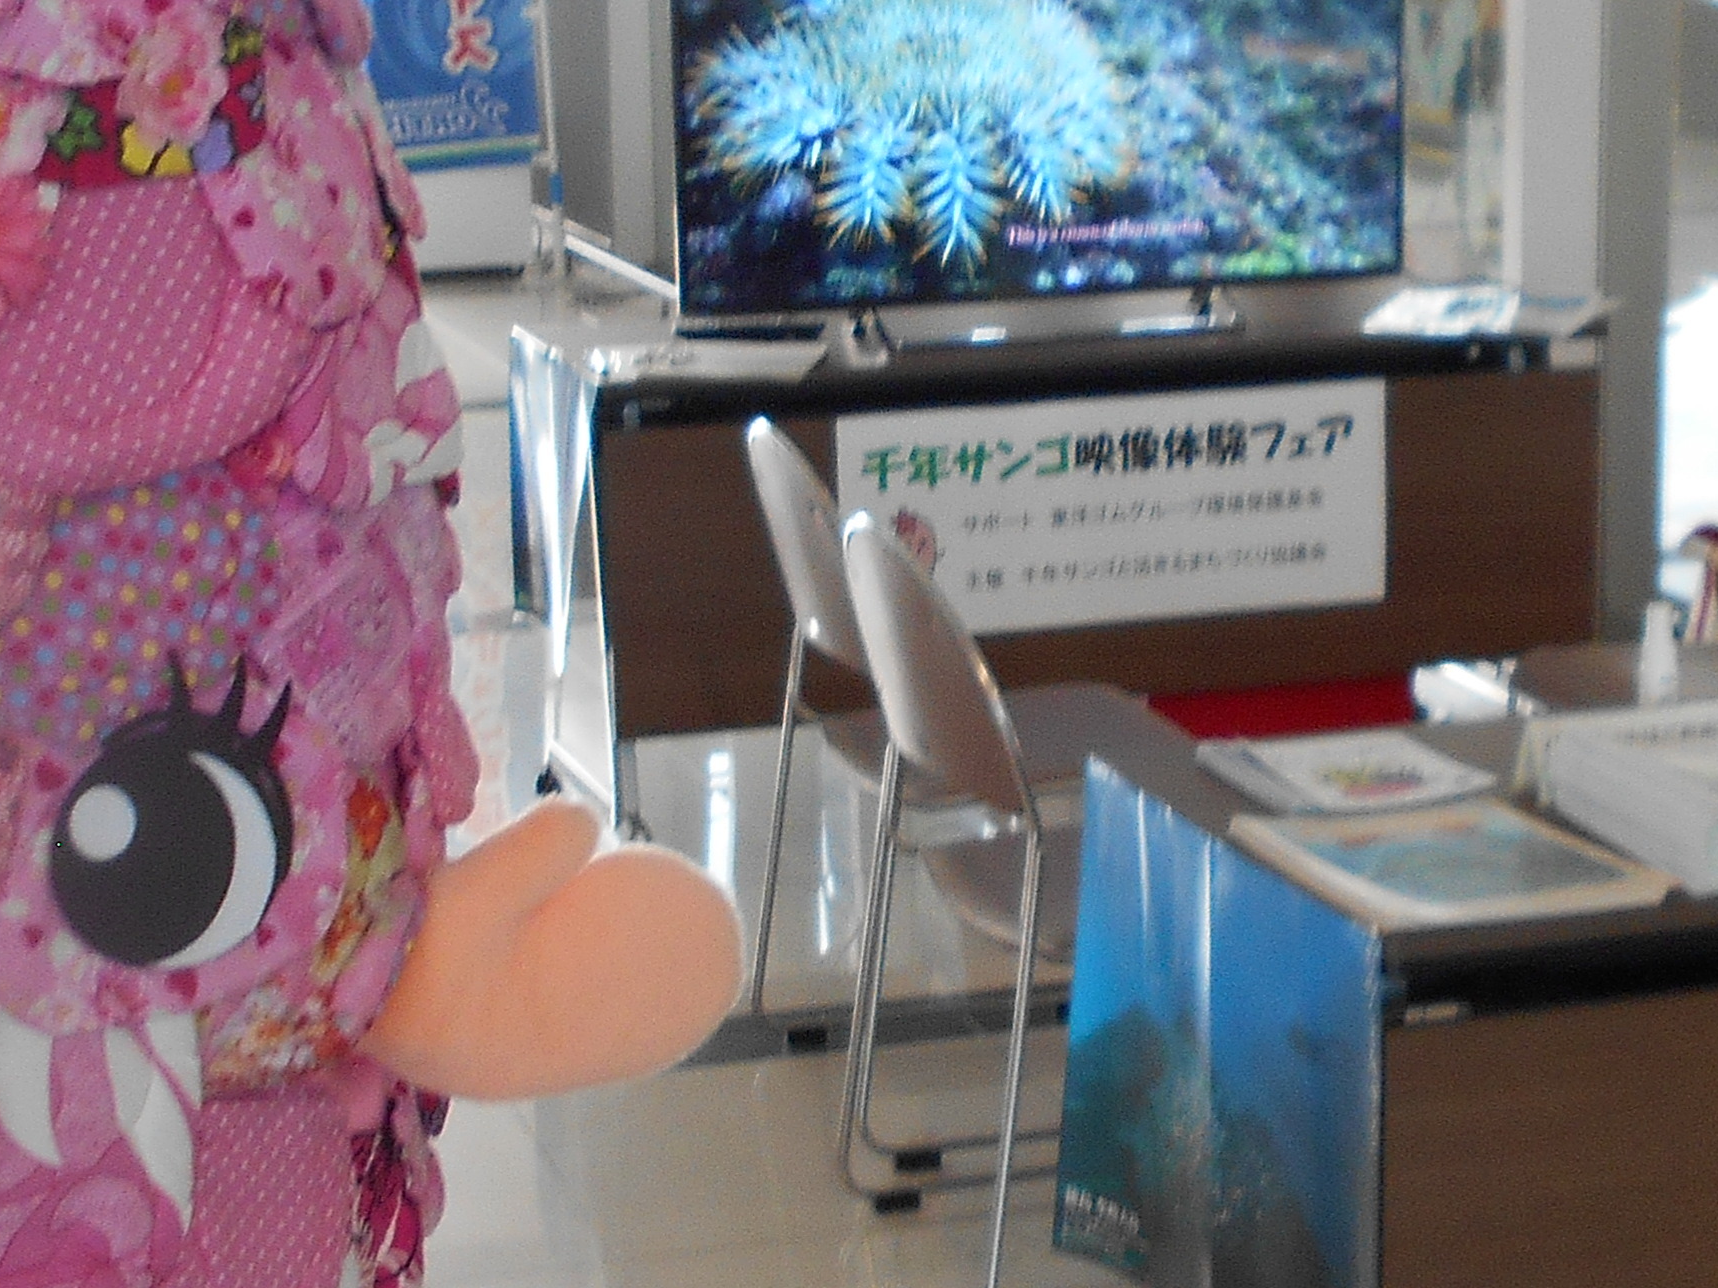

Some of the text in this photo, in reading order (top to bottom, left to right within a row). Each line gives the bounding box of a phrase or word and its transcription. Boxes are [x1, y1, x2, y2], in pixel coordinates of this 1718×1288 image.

[861, 413, 1356, 491] 千年サンゴ映像体験フェア
